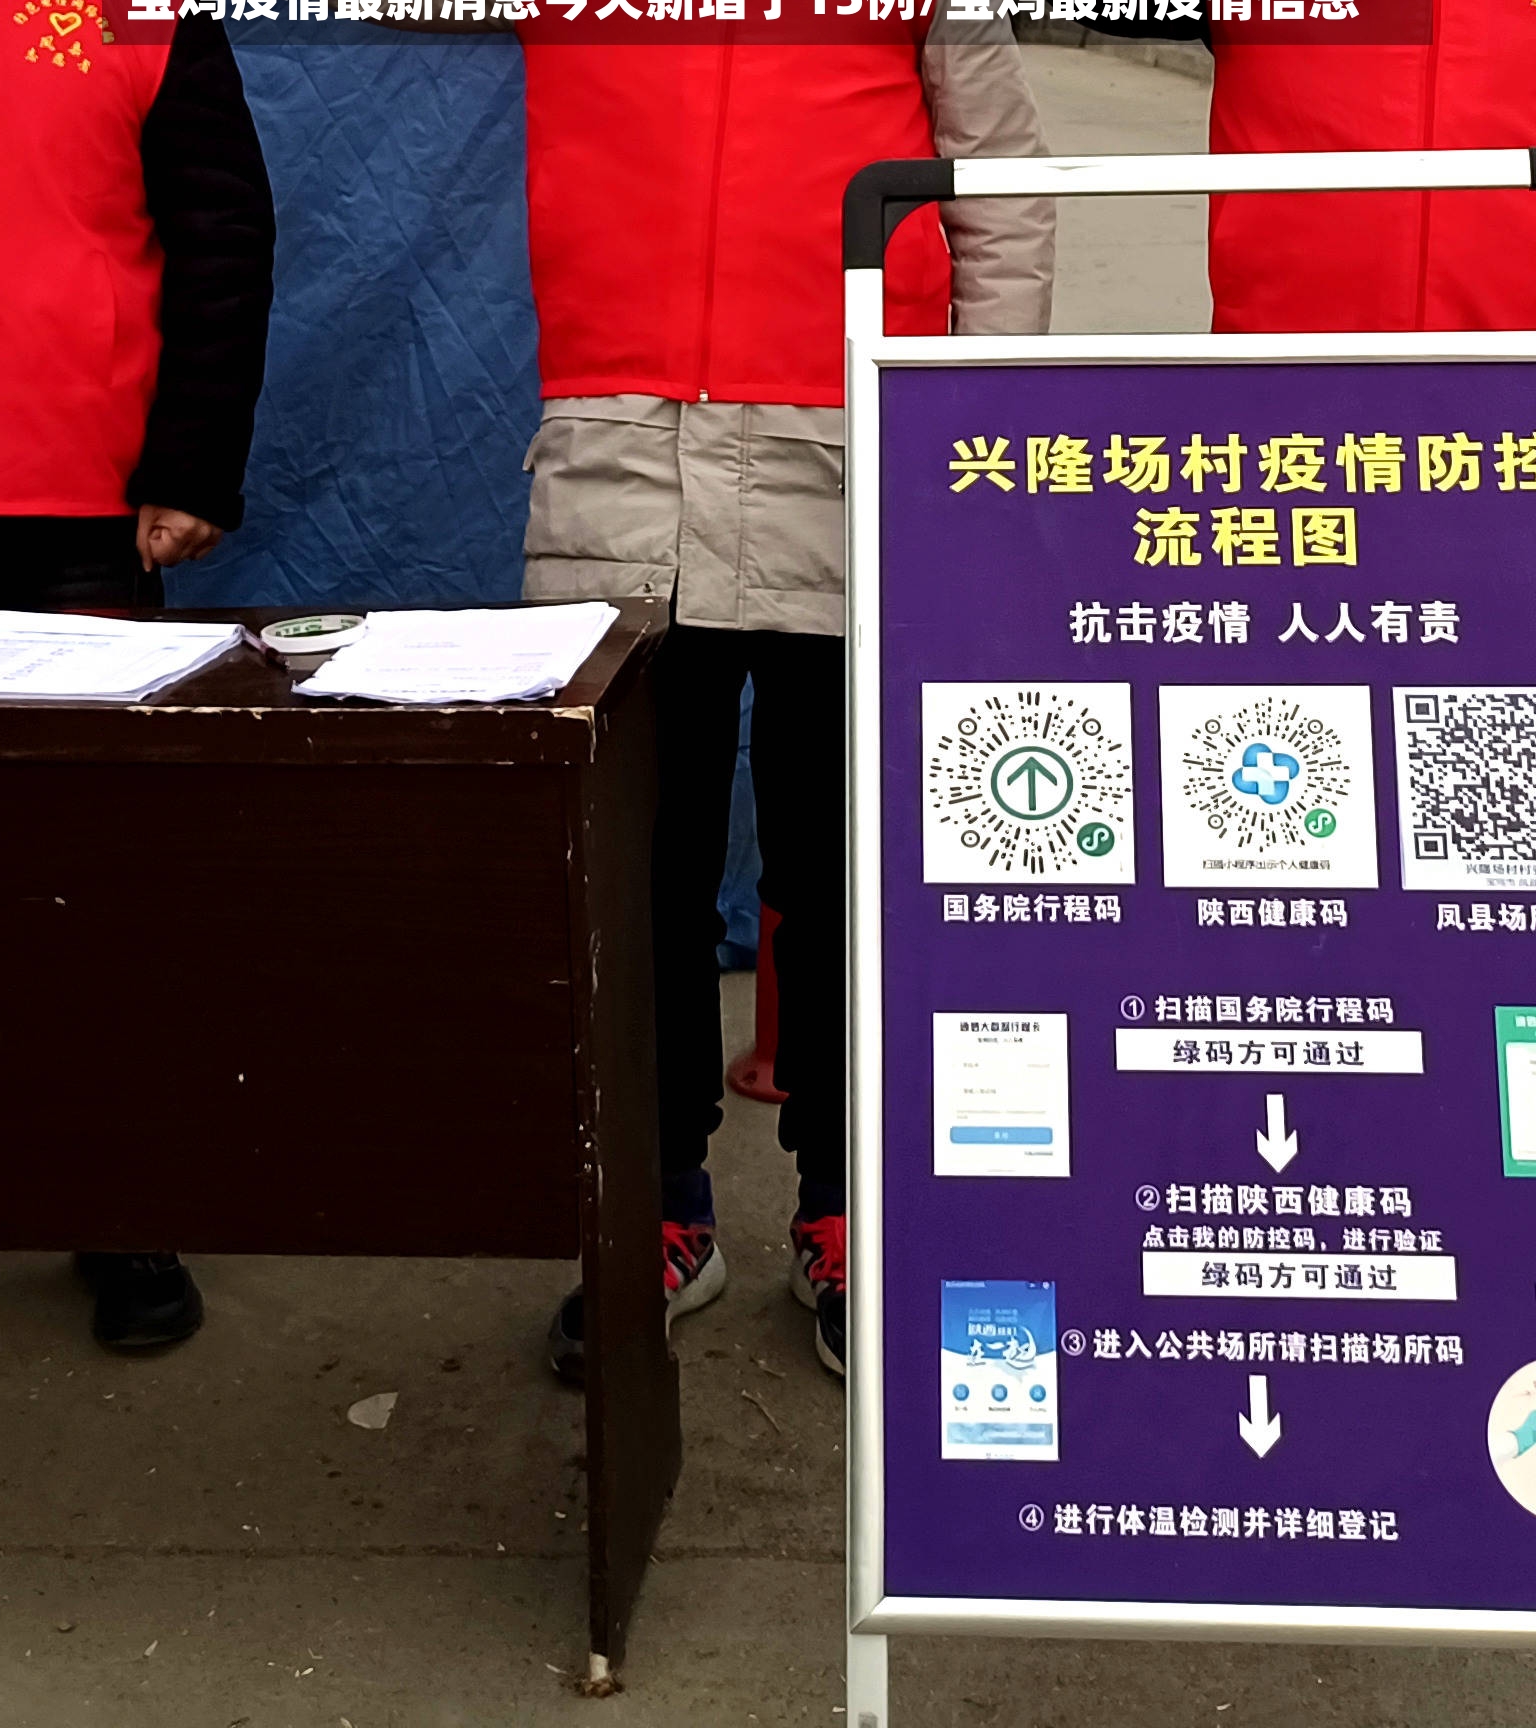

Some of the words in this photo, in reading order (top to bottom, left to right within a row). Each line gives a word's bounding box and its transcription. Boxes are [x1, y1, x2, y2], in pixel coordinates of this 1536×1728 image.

[1132, 506, 1357, 567] 流程图
[1069, 600, 1251, 644] 抗击疫情
[1278, 600, 1460, 644] 人人有责
[943, 893, 1122, 923] 国务院行程码
[1197, 897, 1348, 927] 陕西健康码
[1173, 1039, 1365, 1067] 绿码方可通过
[1201, 1261, 1398, 1293] 绿码方可通过
